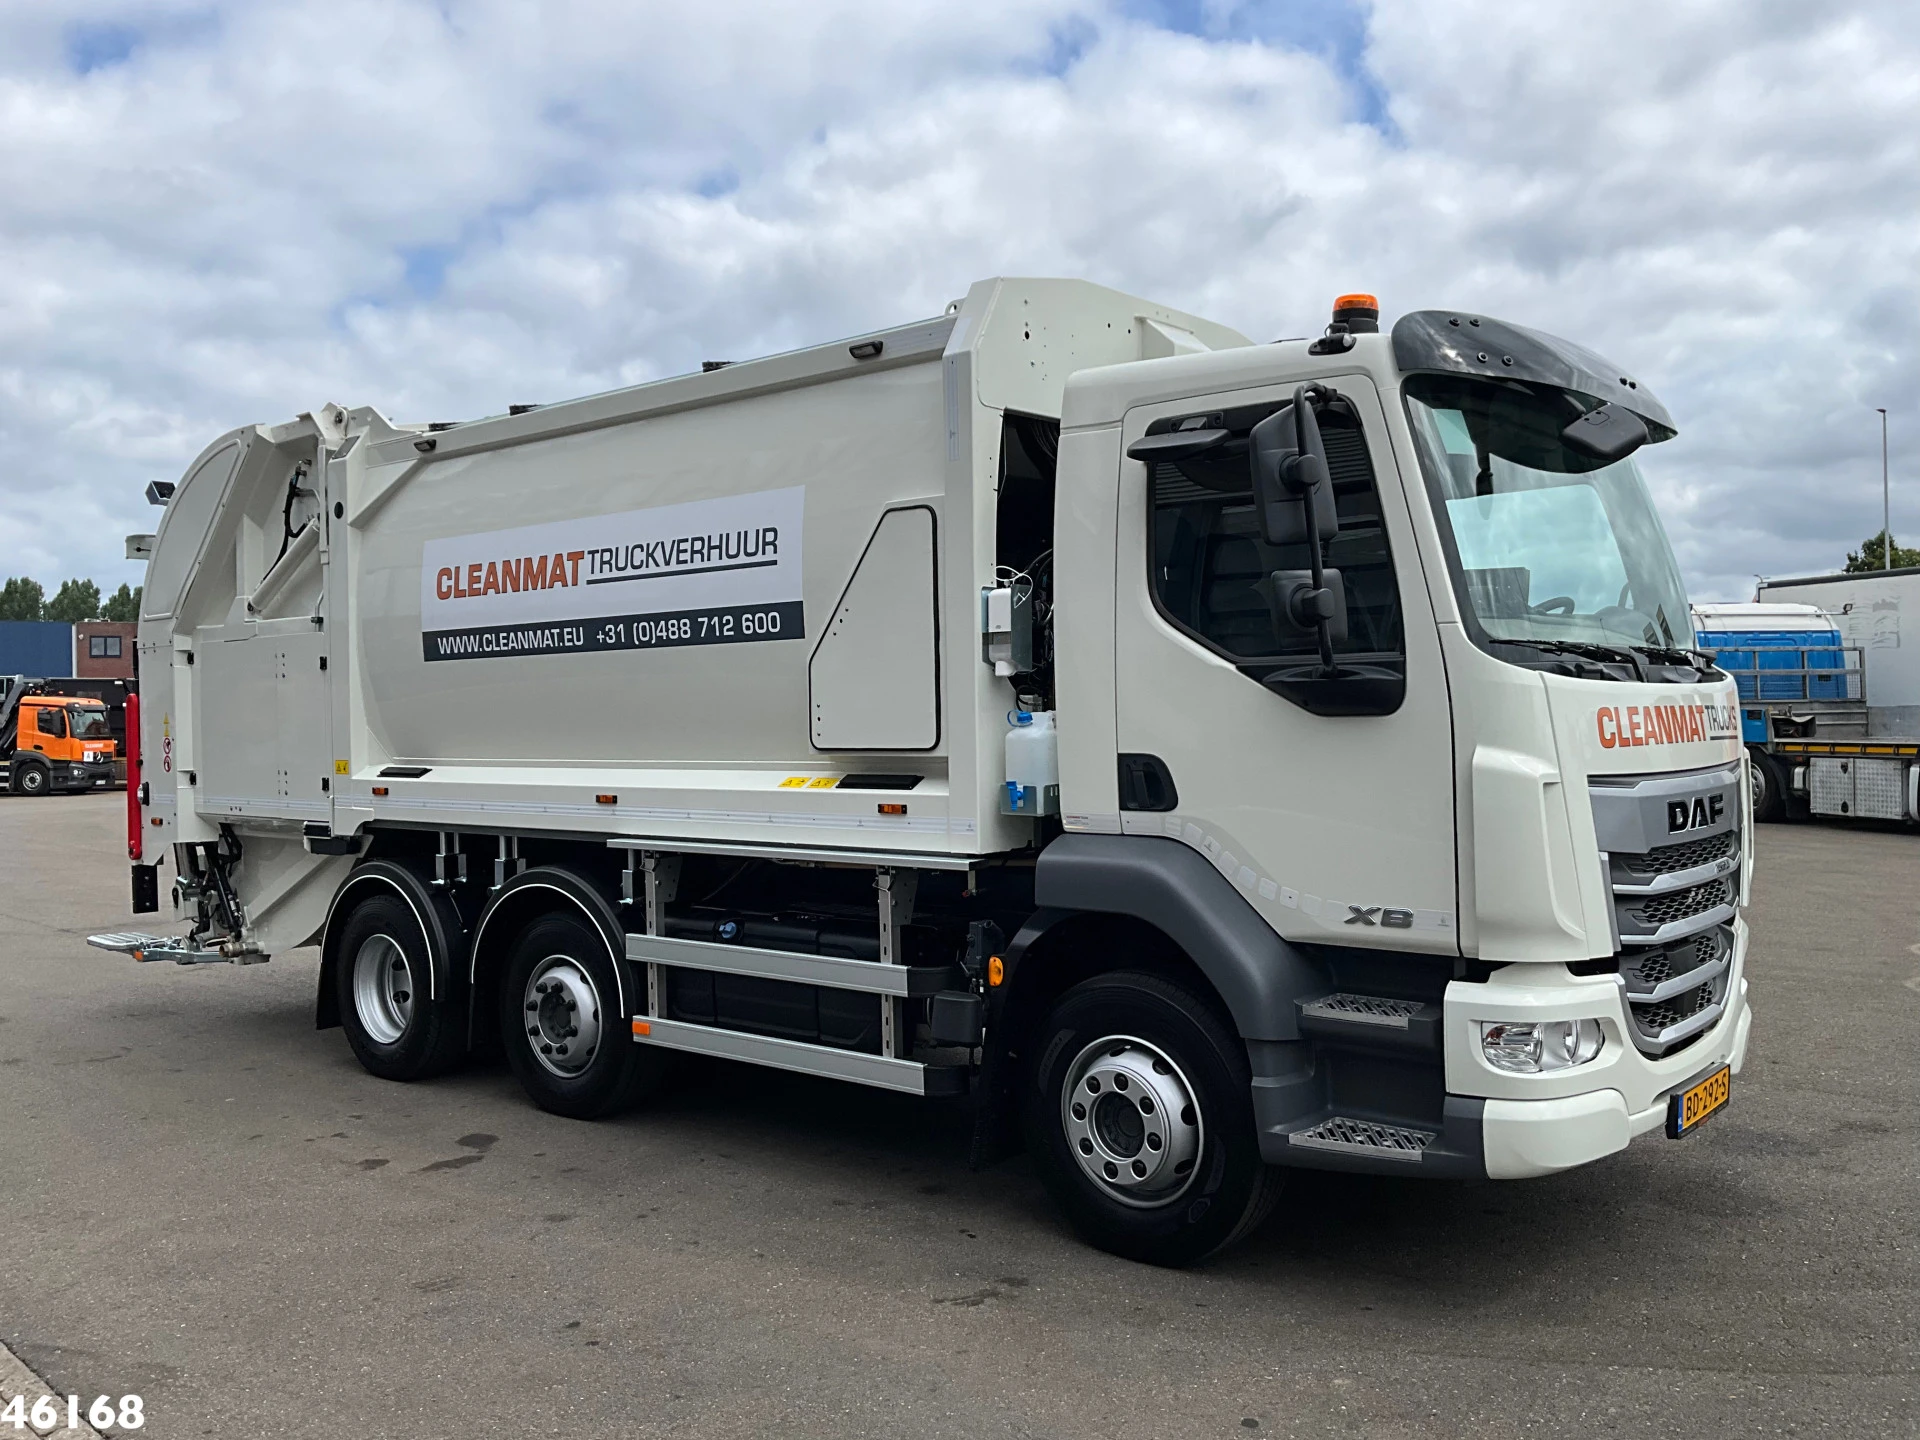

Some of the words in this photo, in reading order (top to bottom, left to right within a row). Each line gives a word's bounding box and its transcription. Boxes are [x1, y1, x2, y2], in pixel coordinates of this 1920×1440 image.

[436, 550, 585, 600] CLEANMAT
[587, 526, 778, 575] TRUCKVERHUUR
[437, 626, 584, 654] WWW.CLEANMAT.EU
[596, 623, 626, 644] +31
[632, 618, 691, 645] (0)488
[698, 614, 734, 637] 712
[741, 611, 780, 634] 600
[1596, 704, 1707, 749] CLEANMAT
[1704, 704, 1738, 731] TRUCKS
[1667, 792, 1724, 835] DAF
[1686, 1072, 1726, 1121] BD-292-S
